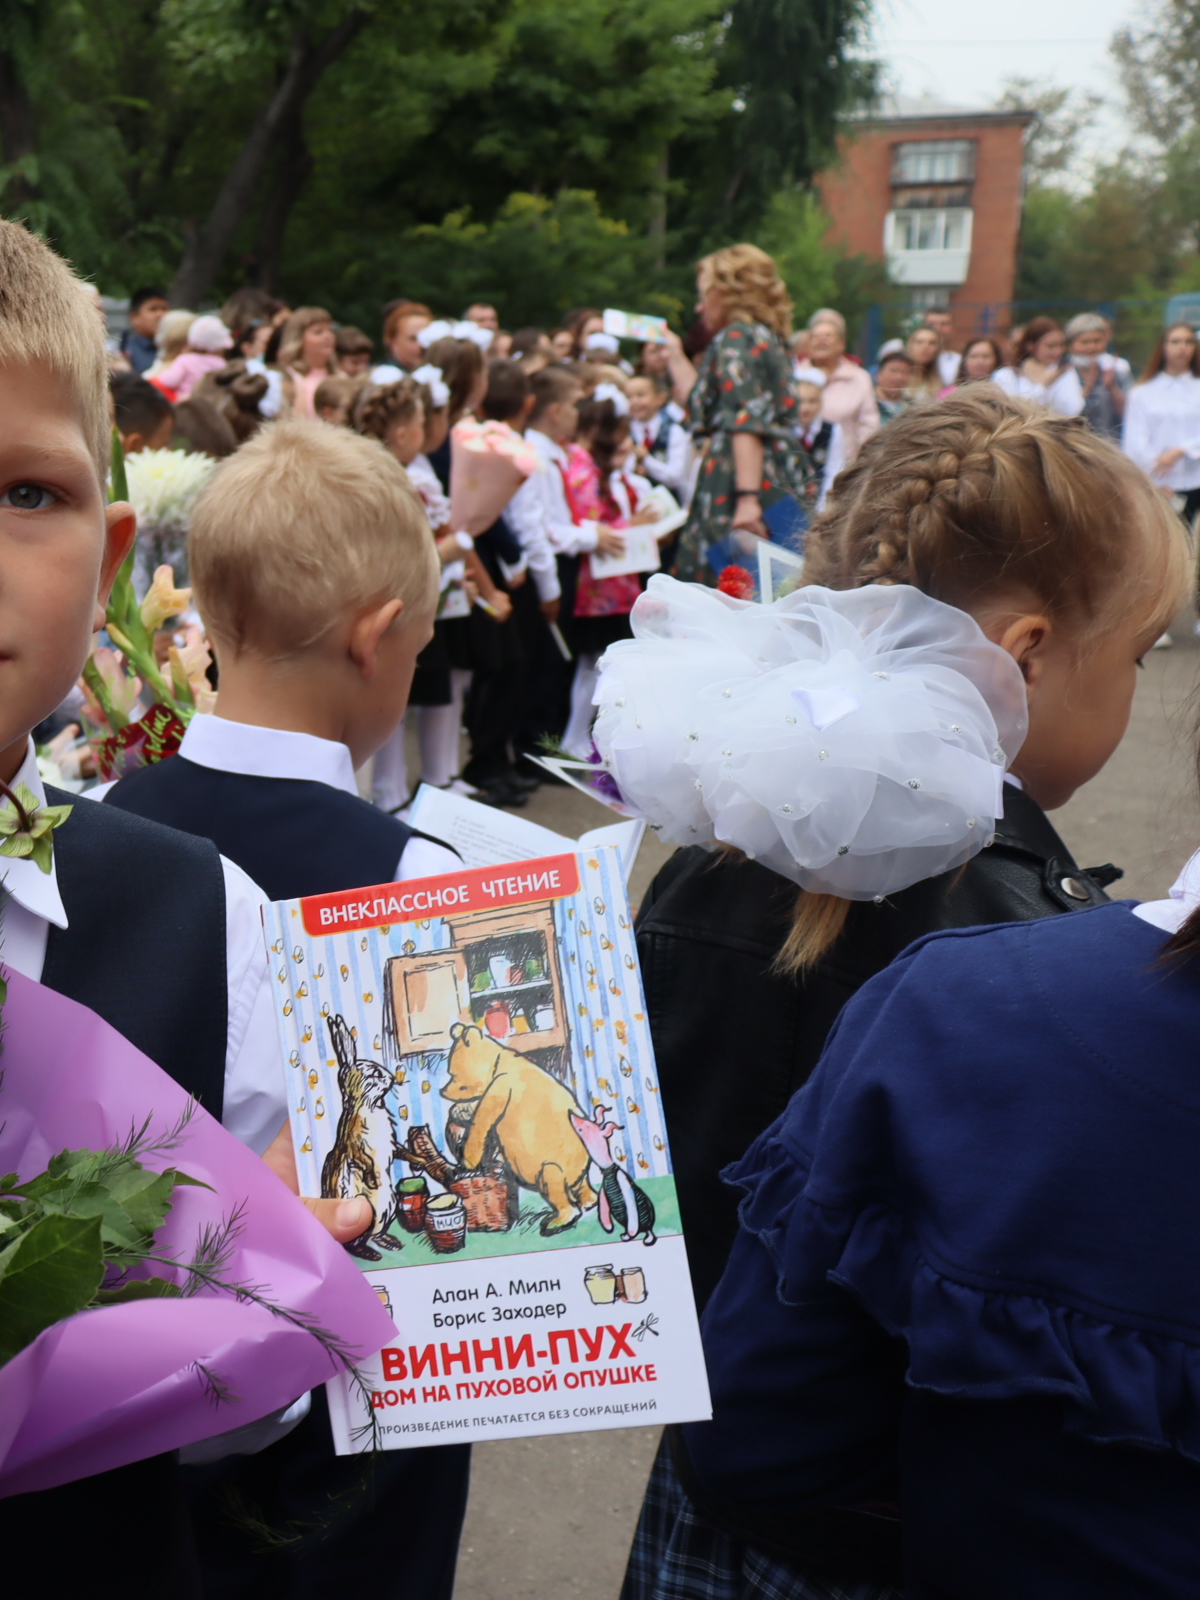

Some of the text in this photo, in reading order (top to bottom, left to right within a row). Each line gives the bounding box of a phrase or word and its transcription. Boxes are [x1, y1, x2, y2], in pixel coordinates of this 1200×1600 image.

[319, 869, 562, 926] ВНЕКЛАССНОЕ ЧТЕНИЕ
[432, 1278, 561, 1305] Алан А. Милн
[432, 1302, 567, 1330] Борис Заходер
[380, 1322, 638, 1382] ВИННИ-ПУХ
[371, 1363, 658, 1410] ДОМ НА ПУХОВОЙ ОПУШКЕ
[378, 1399, 658, 1435] ПРОИЗВЕДЕНИЕ ПЕЧАТАЕТСЯ БЕЗ СОКРАЩЕНИЙ
